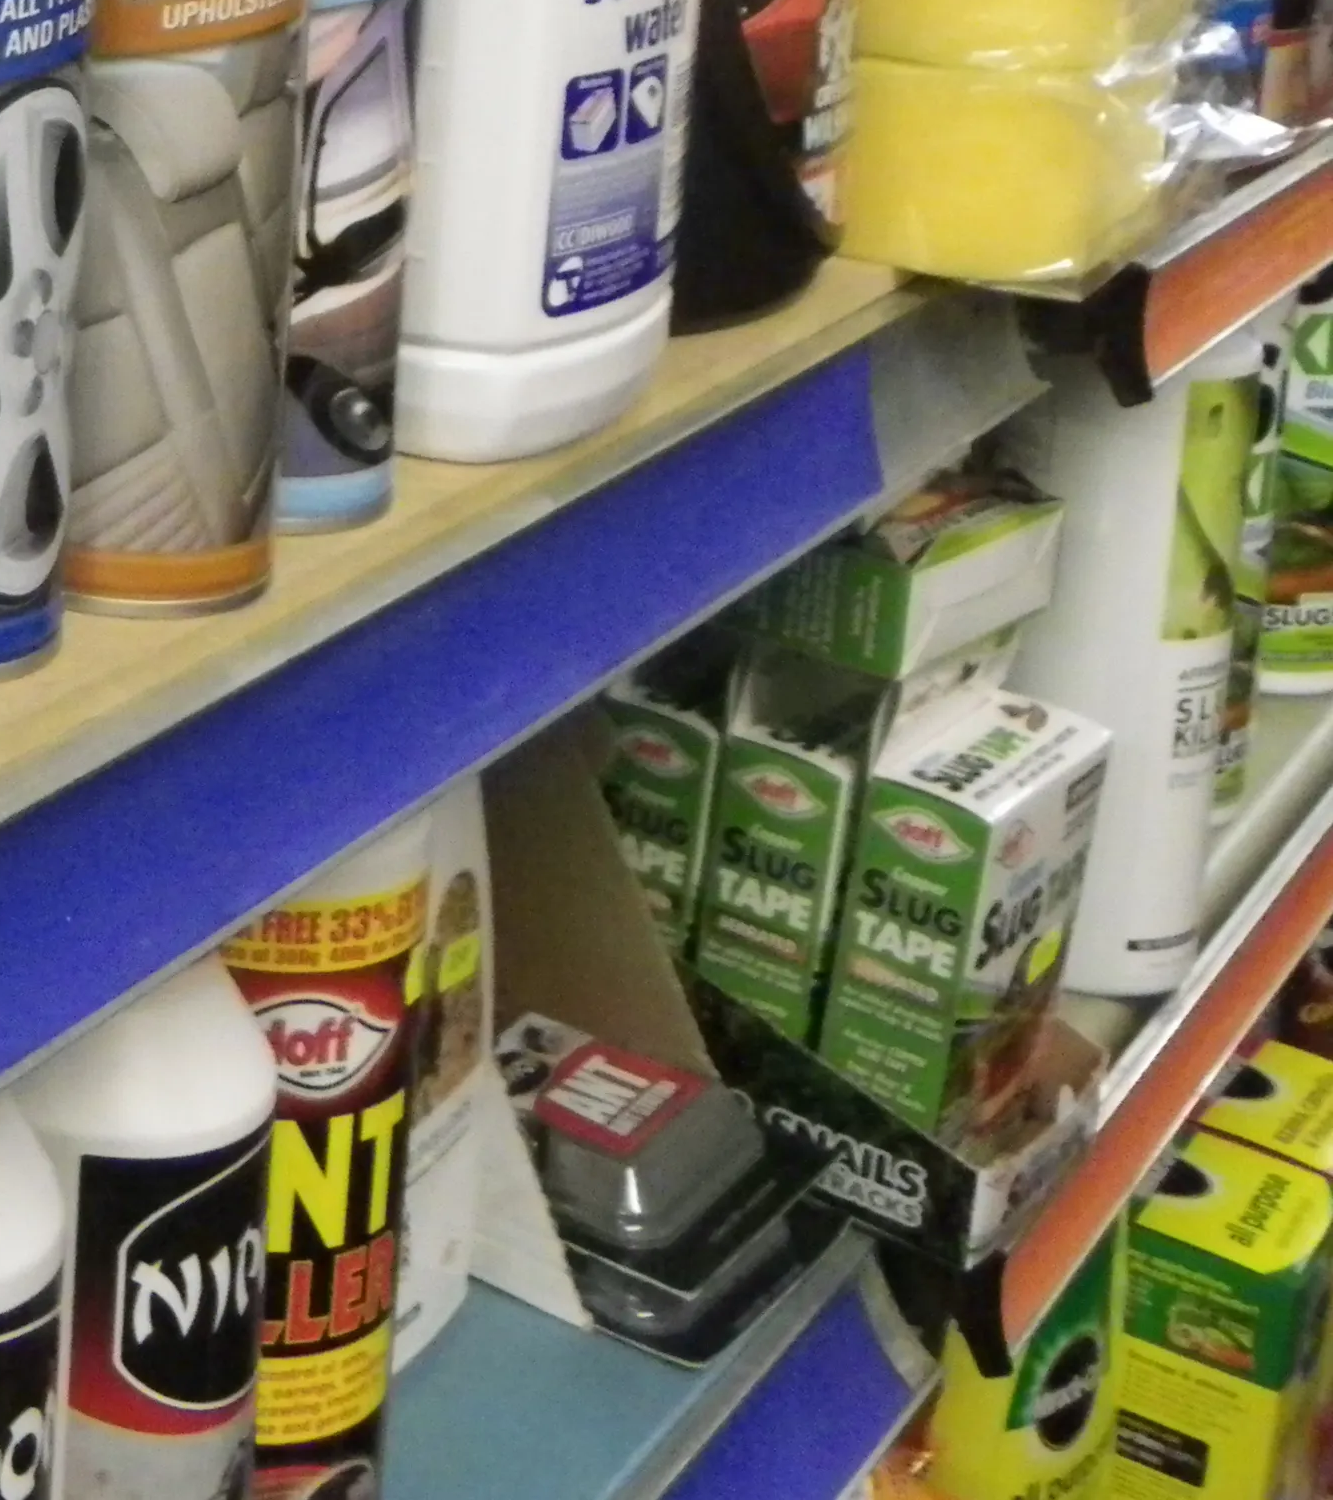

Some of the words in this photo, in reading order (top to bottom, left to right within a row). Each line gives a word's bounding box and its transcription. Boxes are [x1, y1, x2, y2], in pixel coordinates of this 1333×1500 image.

[4, 20, 54, 58] AND
[1265, 606, 1333, 629] SLUG
[720, 825, 817, 891] SLUG
[716, 866, 813, 933] TAPE
[860, 867, 965, 938] SLUG
[853, 909, 958, 979] TAPE
[266, 1090, 405, 1254] NT
